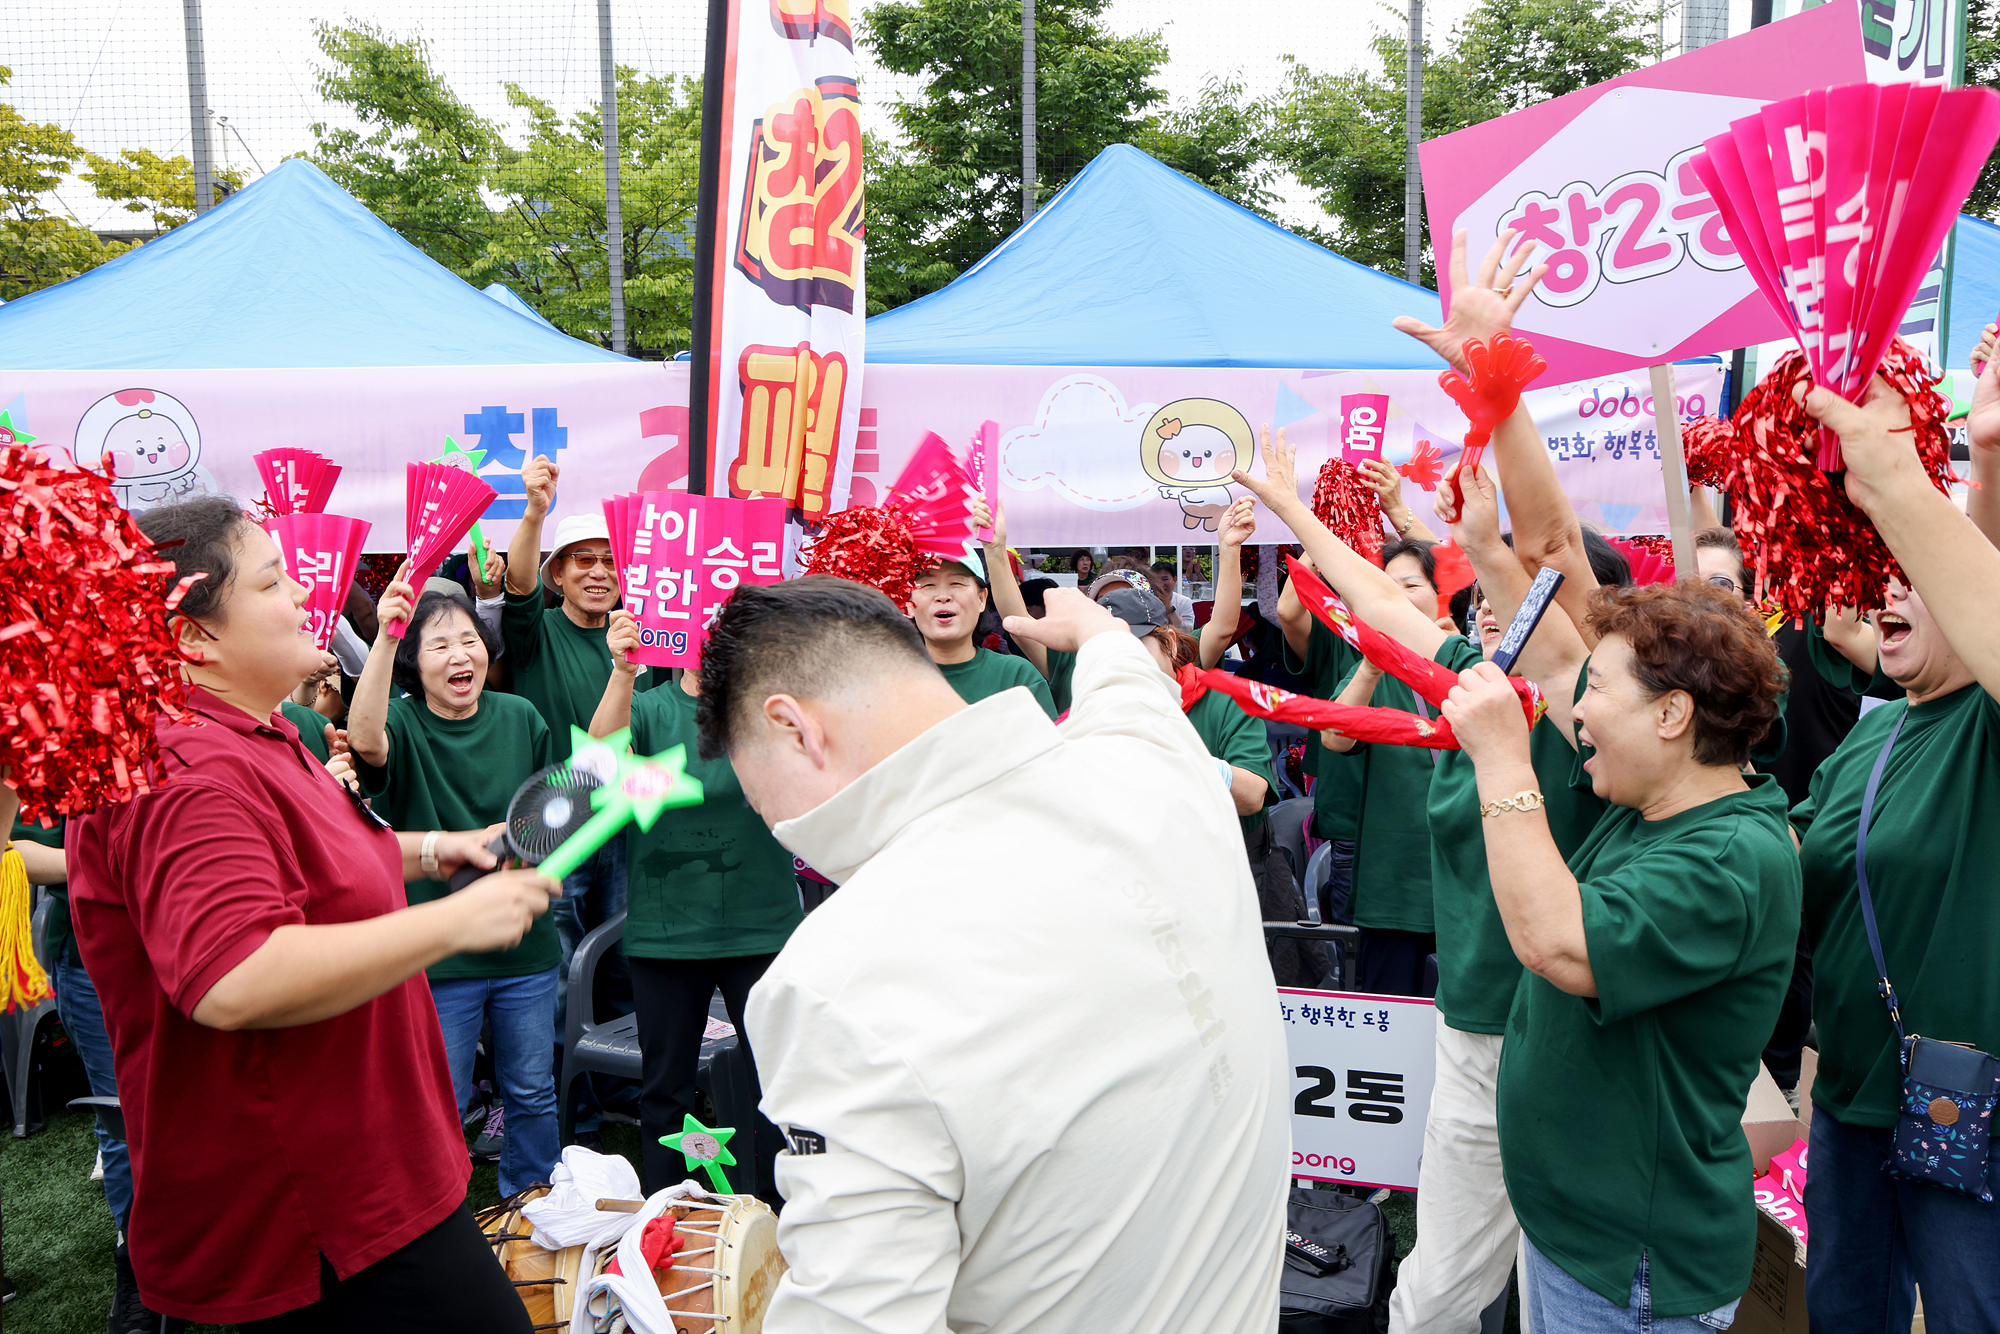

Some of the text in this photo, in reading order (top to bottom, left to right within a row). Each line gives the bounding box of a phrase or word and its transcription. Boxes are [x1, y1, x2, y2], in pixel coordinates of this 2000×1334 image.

[1547, 431, 1596, 463] 변화,
[1300, 1003, 1356, 1028] 행복한
[1362, 1009, 1390, 1033] 도봉
